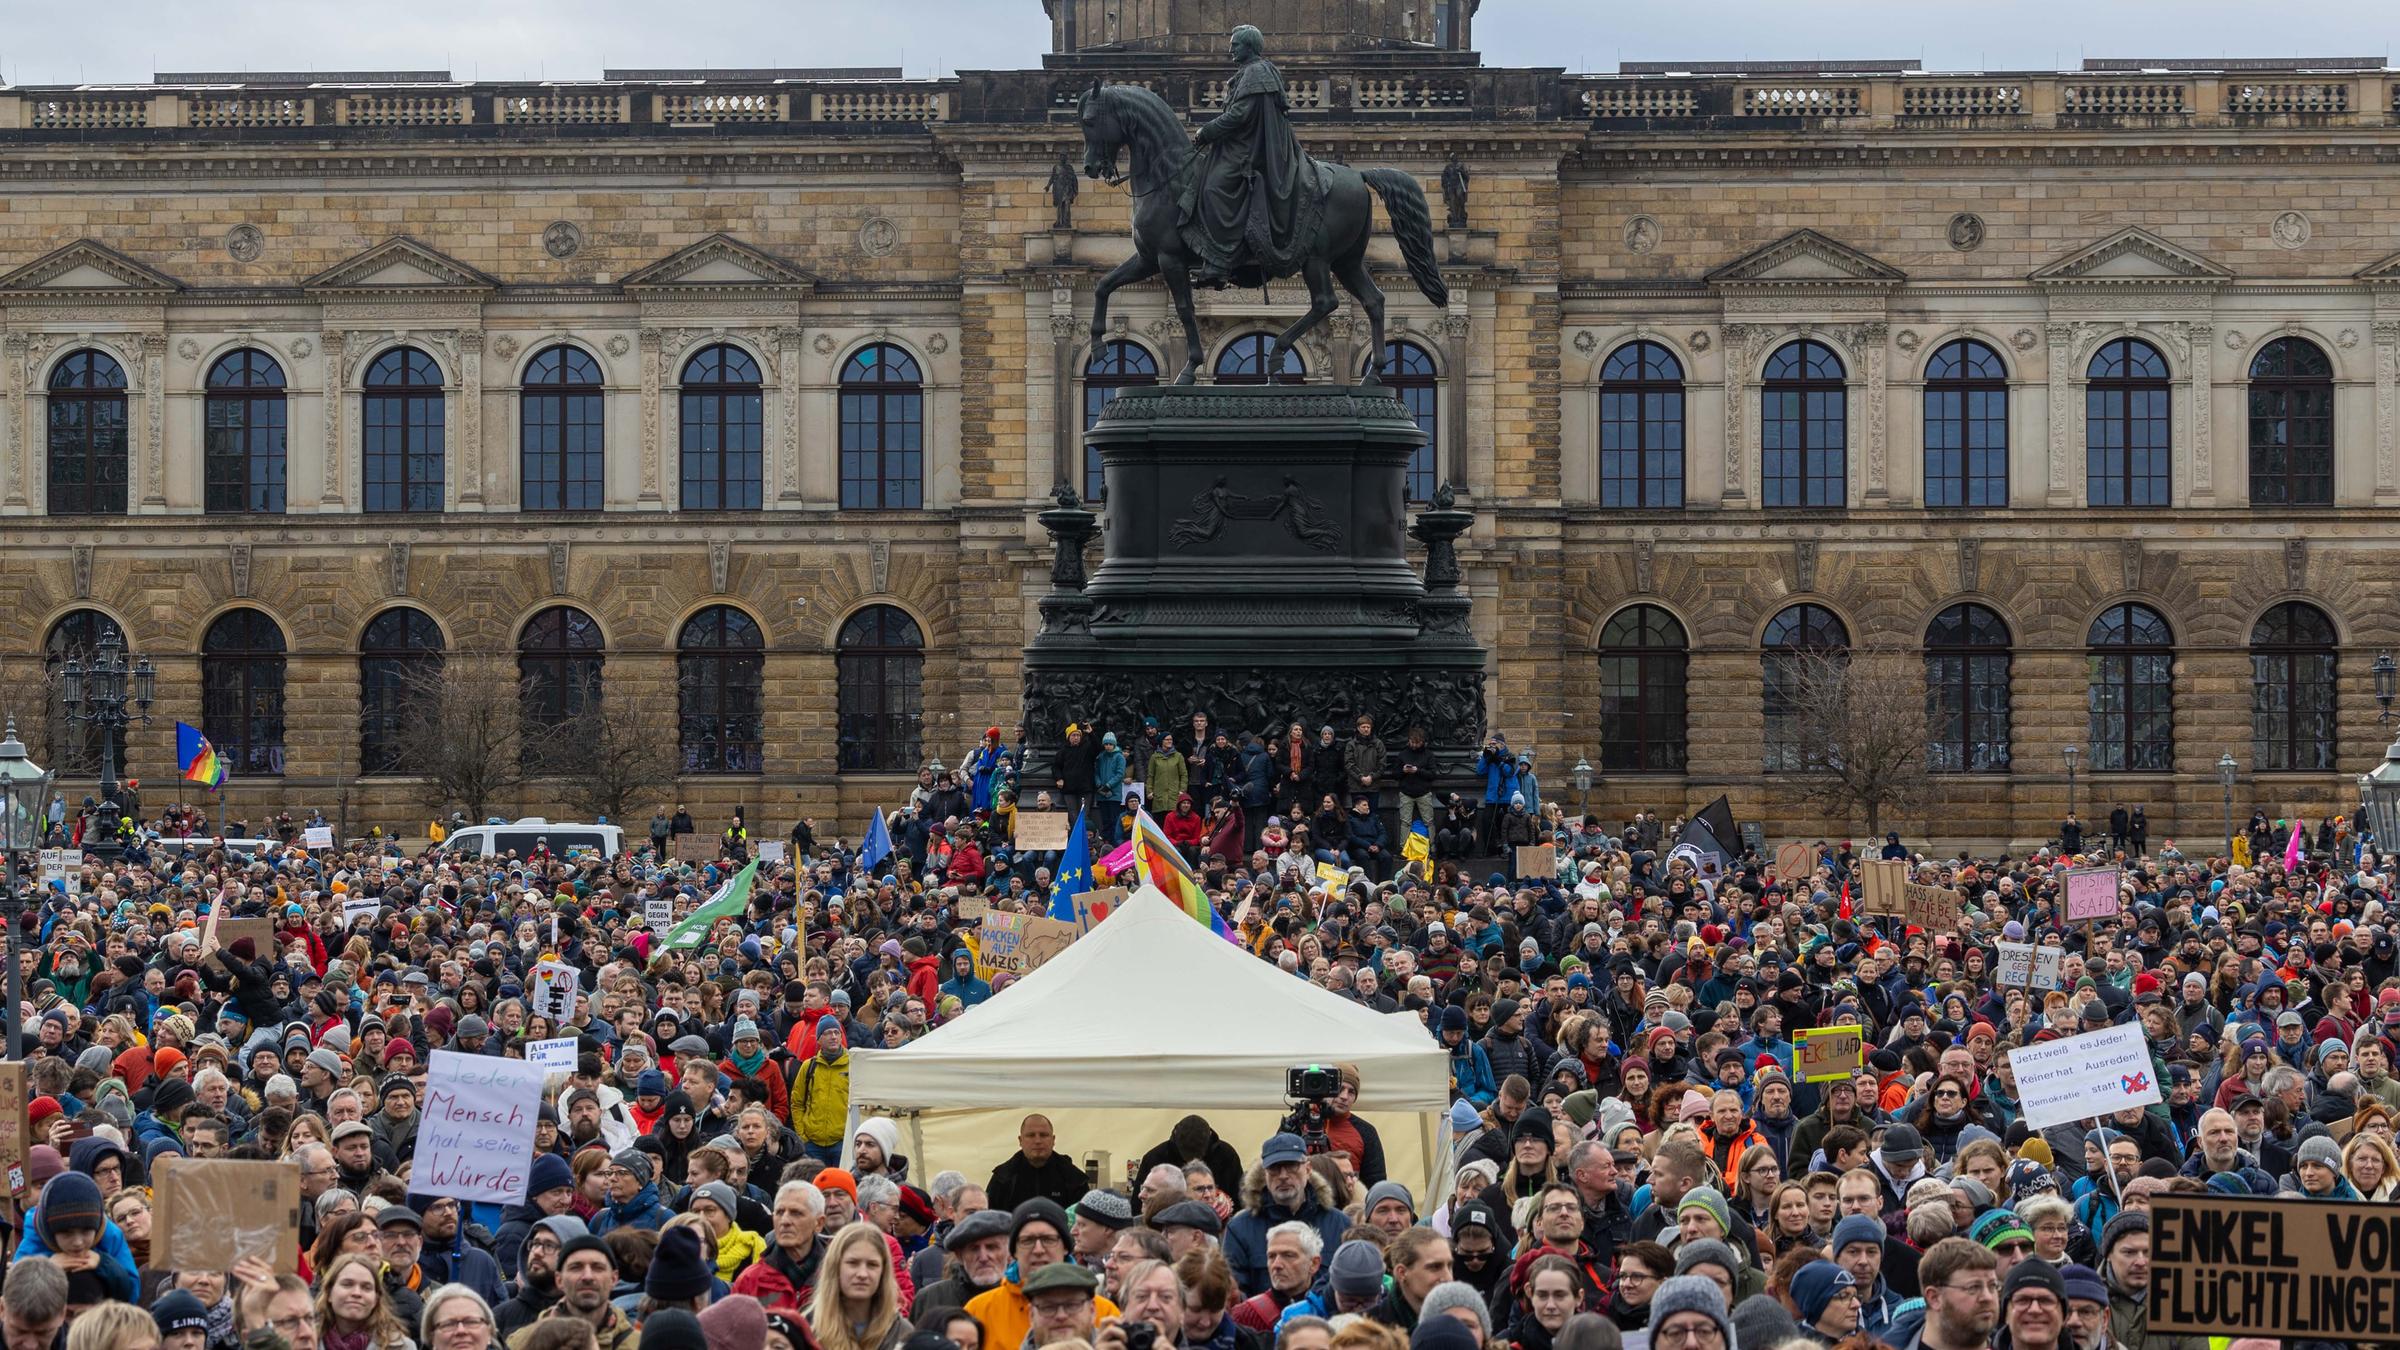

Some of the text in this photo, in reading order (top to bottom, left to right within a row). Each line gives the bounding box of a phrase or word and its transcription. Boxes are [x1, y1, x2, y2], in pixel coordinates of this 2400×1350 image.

[41, 852, 58, 860] AUF
[1905, 885, 1926, 901] HASS
[982, 928, 1020, 945] KACKEN
[991, 943, 1015, 955] AUF
[980, 952, 1019, 971] NAZIS
[530, 1052, 548, 1062] FÜR
[2016, 1033, 2128, 1065] Jetzt weiß es Jeder!
[447, 1058, 528, 1088] Jeder
[2020, 1051, 2140, 1085] Keiner hat Ausreden!
[424, 1090, 524, 1127] Mensch
[2027, 1090, 2080, 1108] Demokratie
[2091, 1081, 2117, 1094] statt
[428, 1125, 521, 1155] hat seine
[431, 1152, 521, 1192] Würde
[2151, 1206, 2299, 1268] ENKEL
